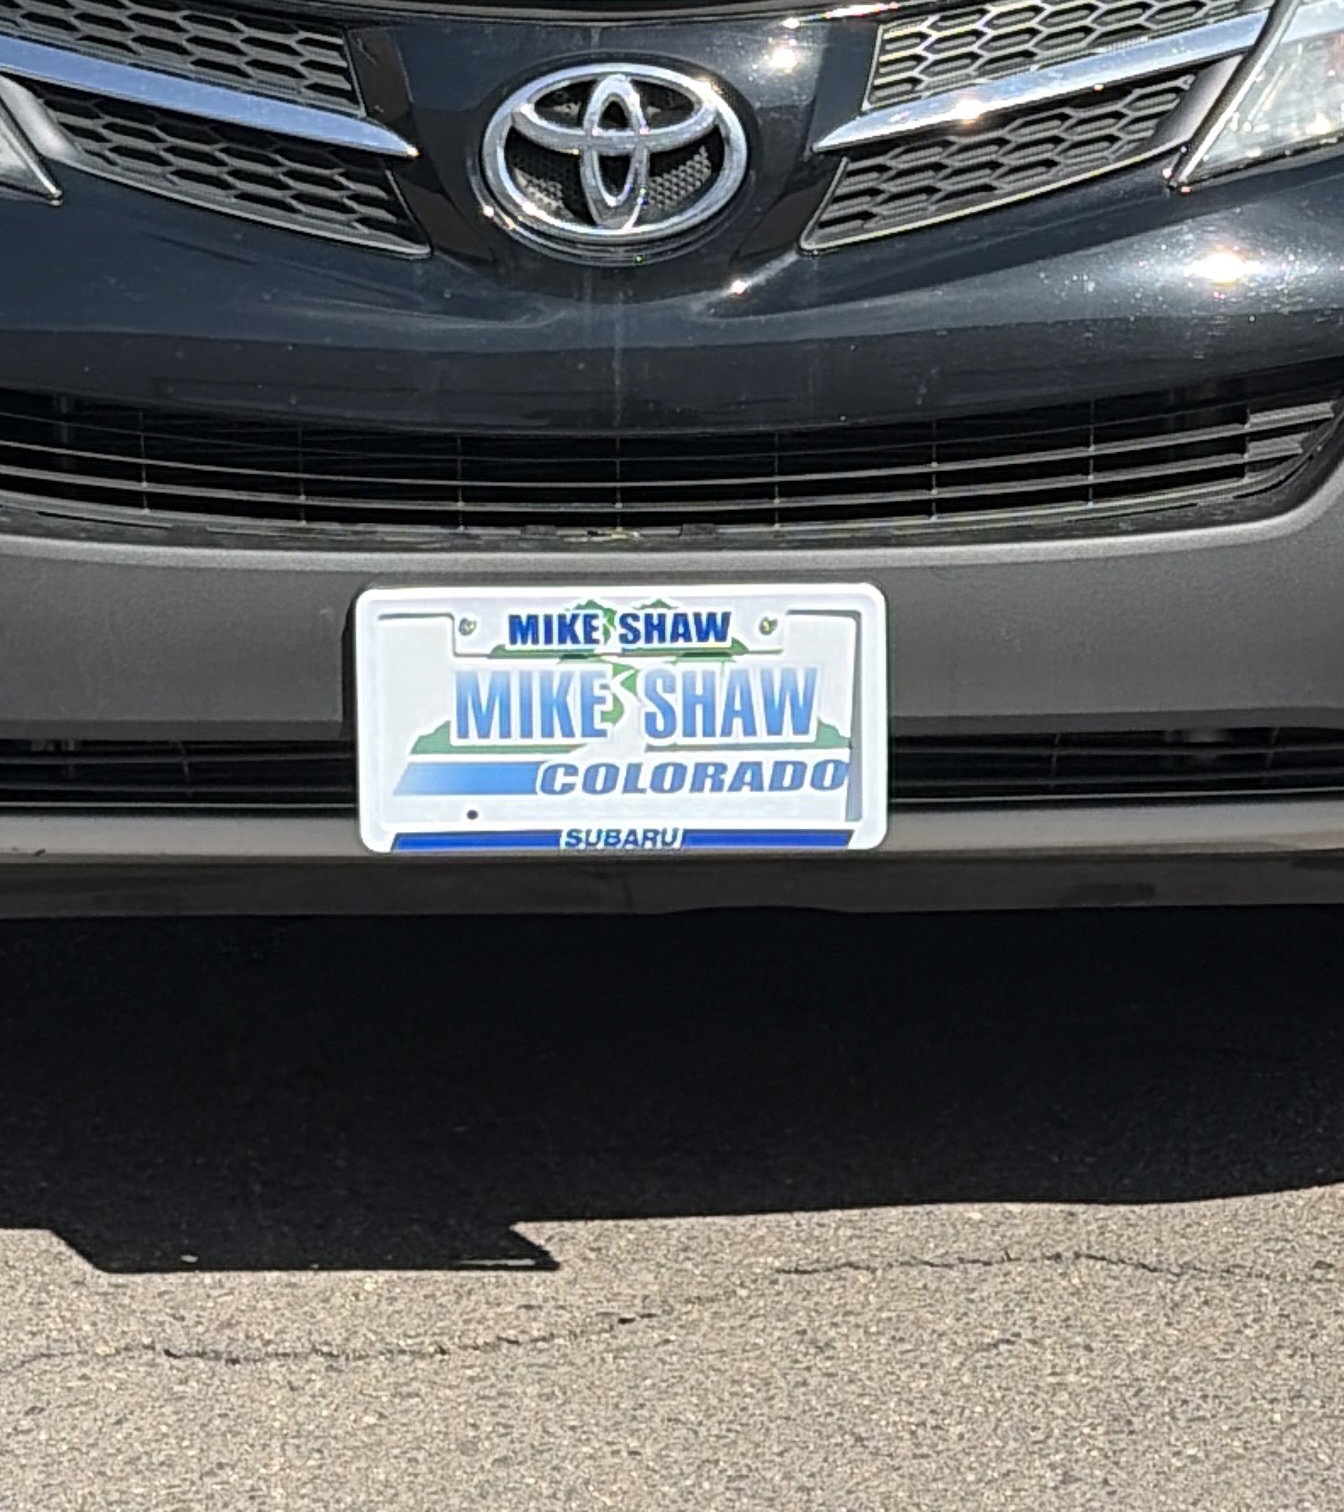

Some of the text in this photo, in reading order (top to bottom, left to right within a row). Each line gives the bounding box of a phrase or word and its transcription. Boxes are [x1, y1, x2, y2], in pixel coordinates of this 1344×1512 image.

[508, 610, 732, 646] MIKE SHAW
[455, 666, 818, 739] MIKE SHAW
[540, 759, 850, 795] COLORADO
[564, 827, 681, 848] SUBARU
